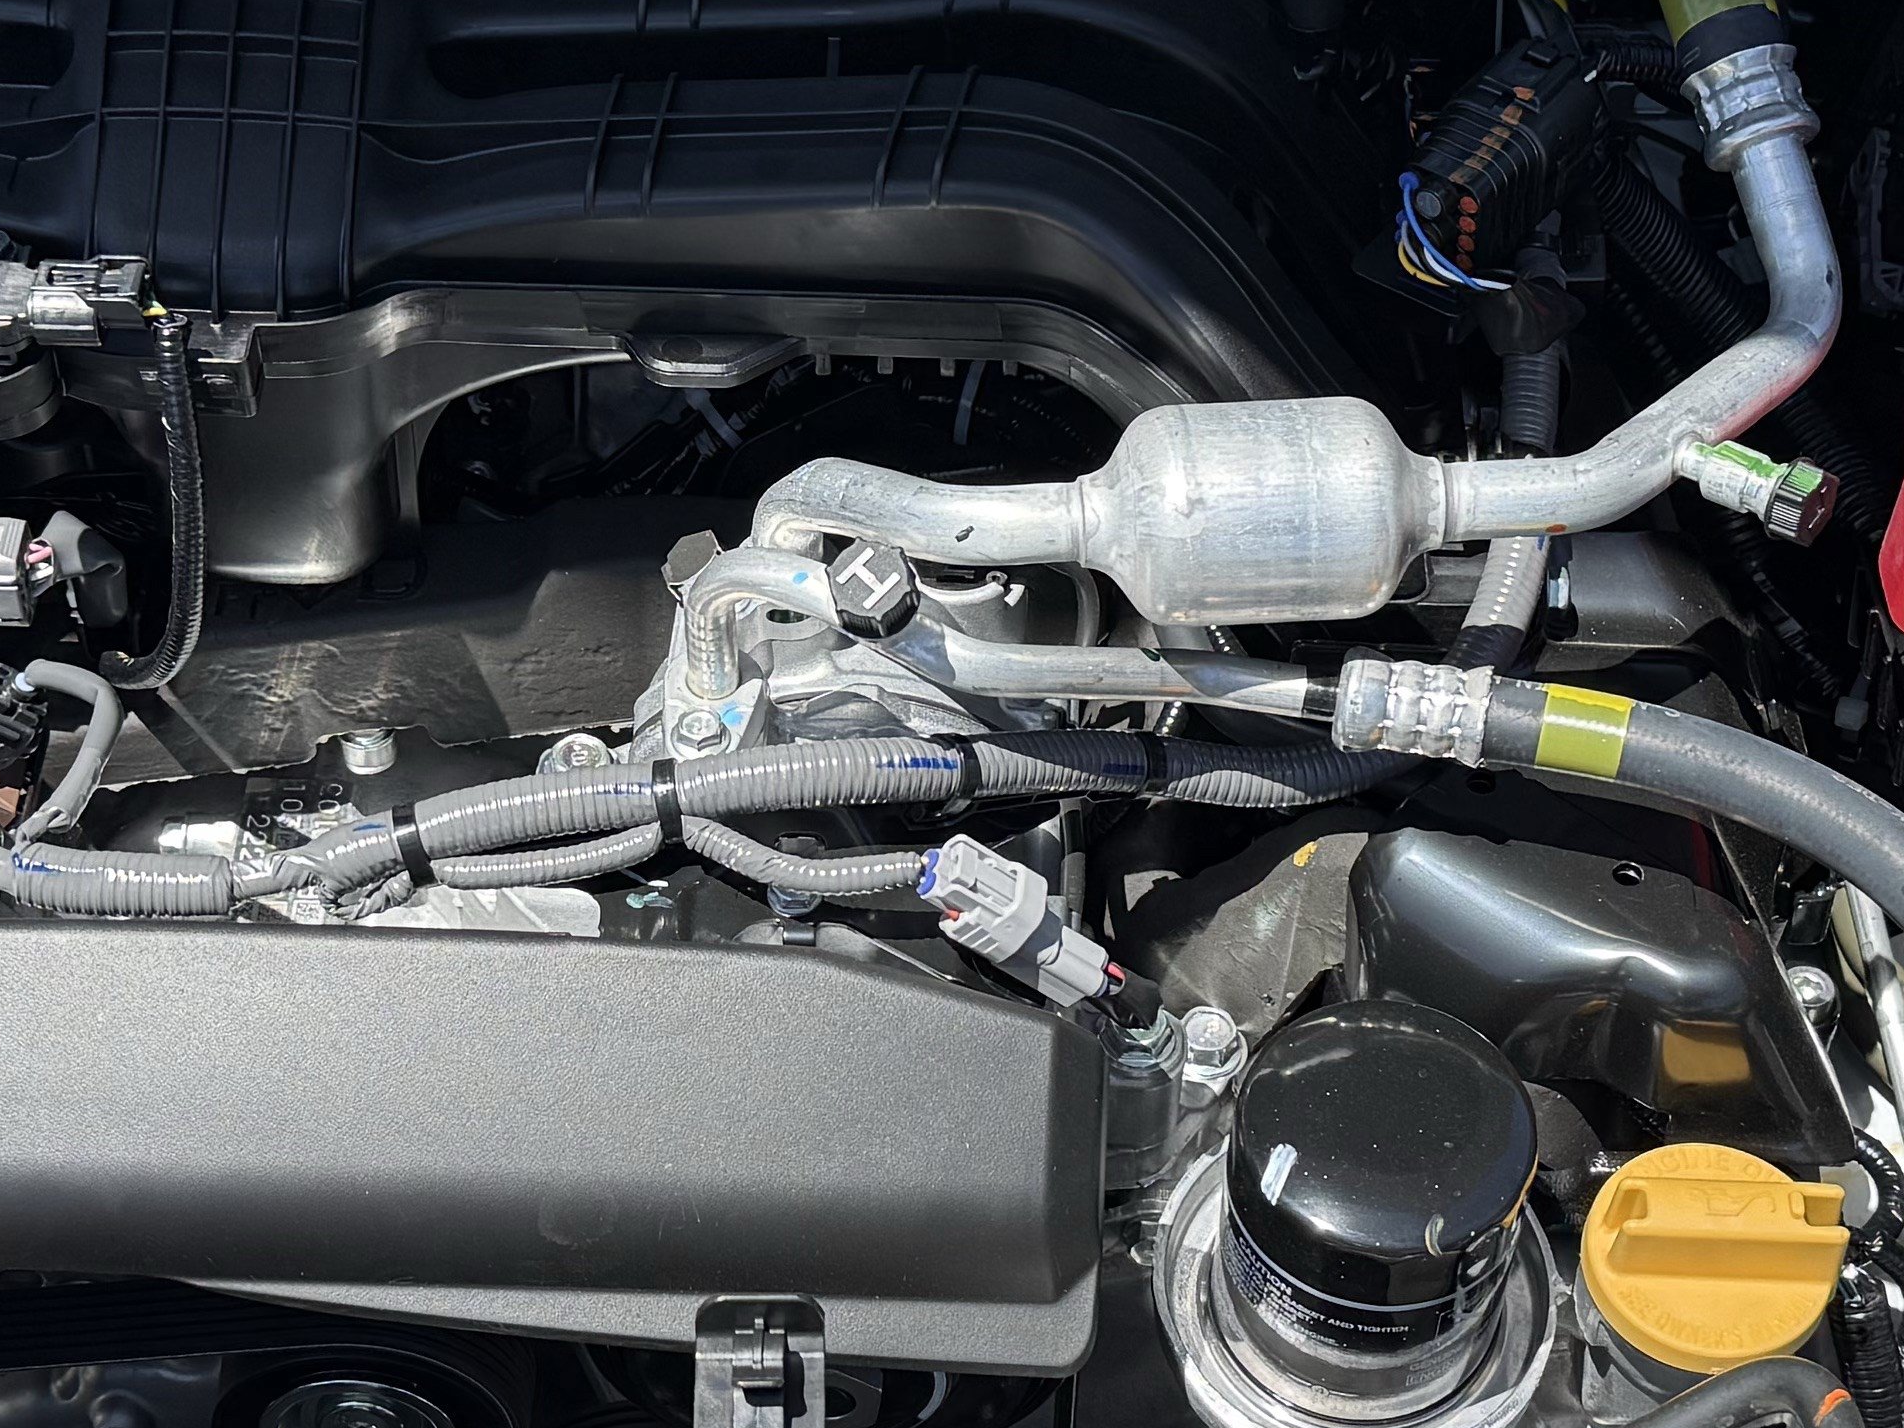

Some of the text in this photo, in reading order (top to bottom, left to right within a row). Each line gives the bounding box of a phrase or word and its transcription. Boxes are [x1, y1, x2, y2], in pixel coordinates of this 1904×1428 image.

[1238, 1236, 1292, 1295] CAUTION
[1328, 1318, 1354, 1329] AND
[1357, 1325, 1409, 1334] TIGHTEN
